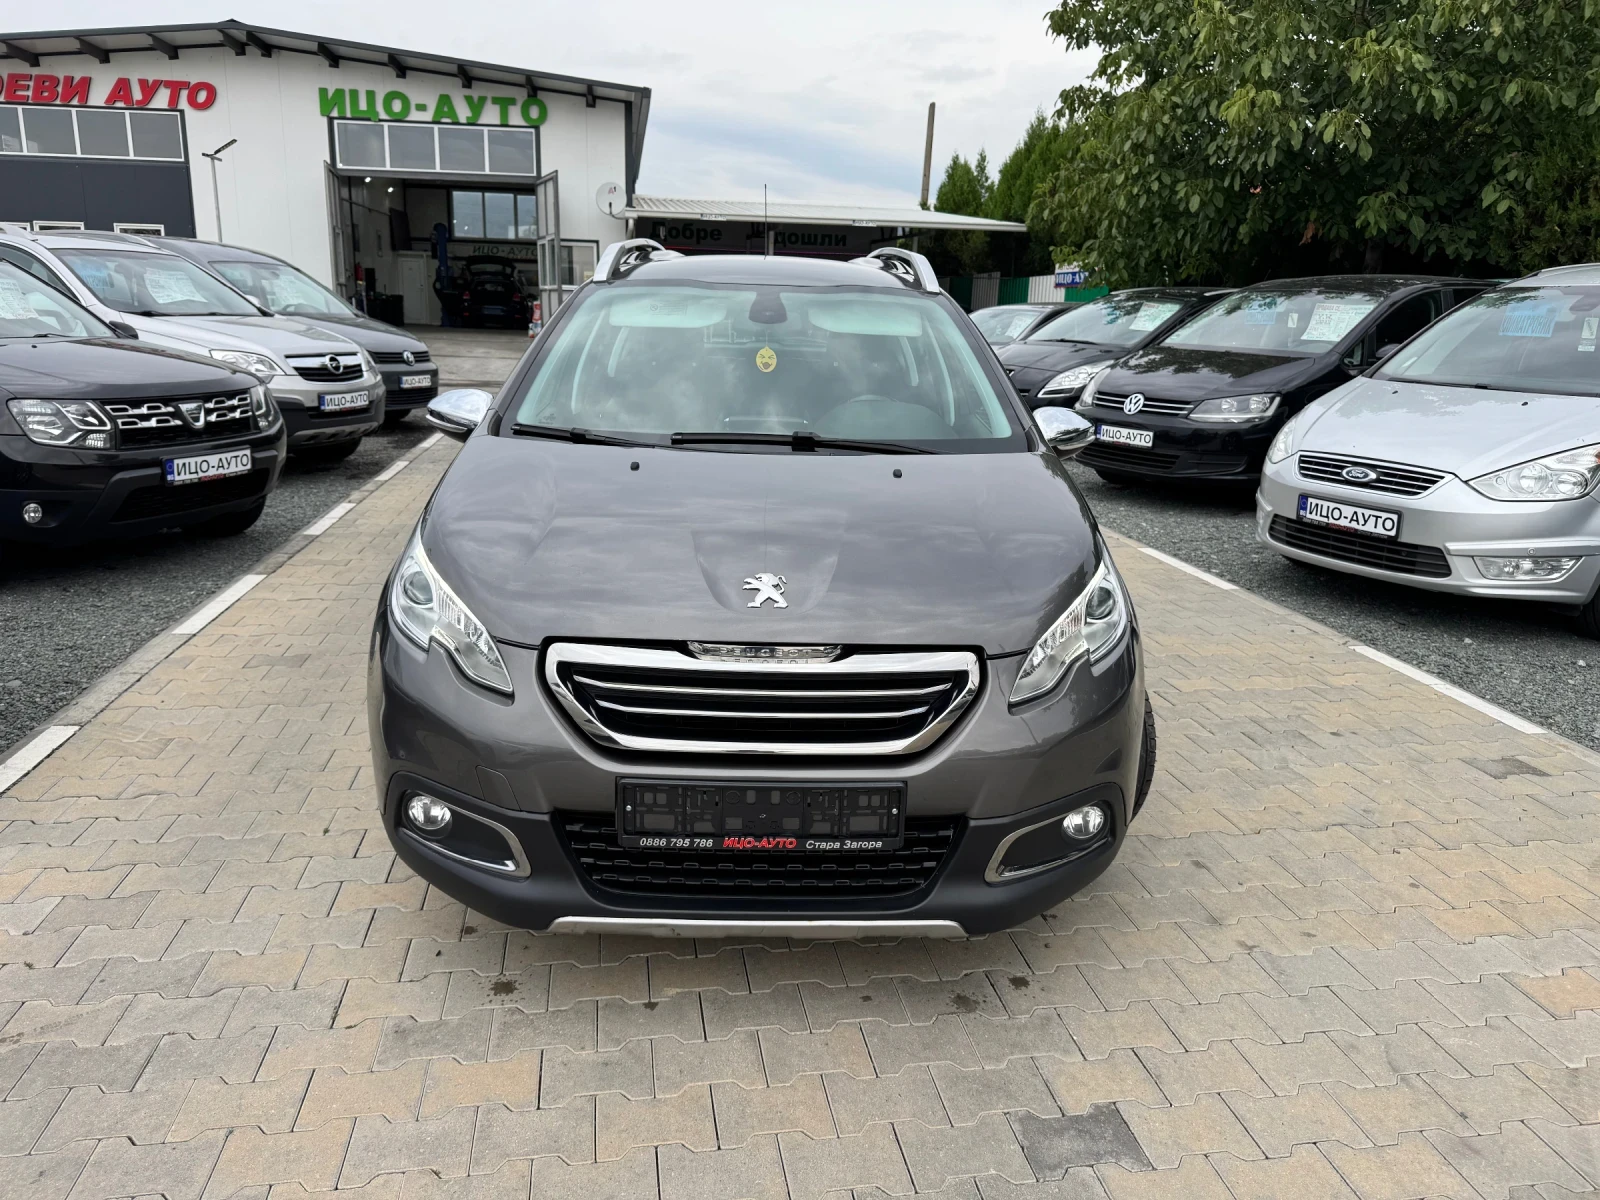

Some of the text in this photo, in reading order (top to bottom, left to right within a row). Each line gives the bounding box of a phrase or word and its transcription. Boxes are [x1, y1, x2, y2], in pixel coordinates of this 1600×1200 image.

[104, 77, 217, 110] АУТО
[318, 87, 548, 126] ИЦО-АУТО
[650, 221, 723, 244] Добре
[326, 393, 368, 408] ИЦО-АУТО
[1102, 428, 1152, 444] ИЦО-АУТО
[177, 454, 250, 477] ИЦО-АУТО
[1348, 468, 1366, 478] Ford
[1309, 501, 1396, 532] ИЦО-АУТО
[720, 646, 812, 657] PEUGEOT
[639, 837, 883, 851] 0886 795 786 ИЦО-АУТО Стара Загора
